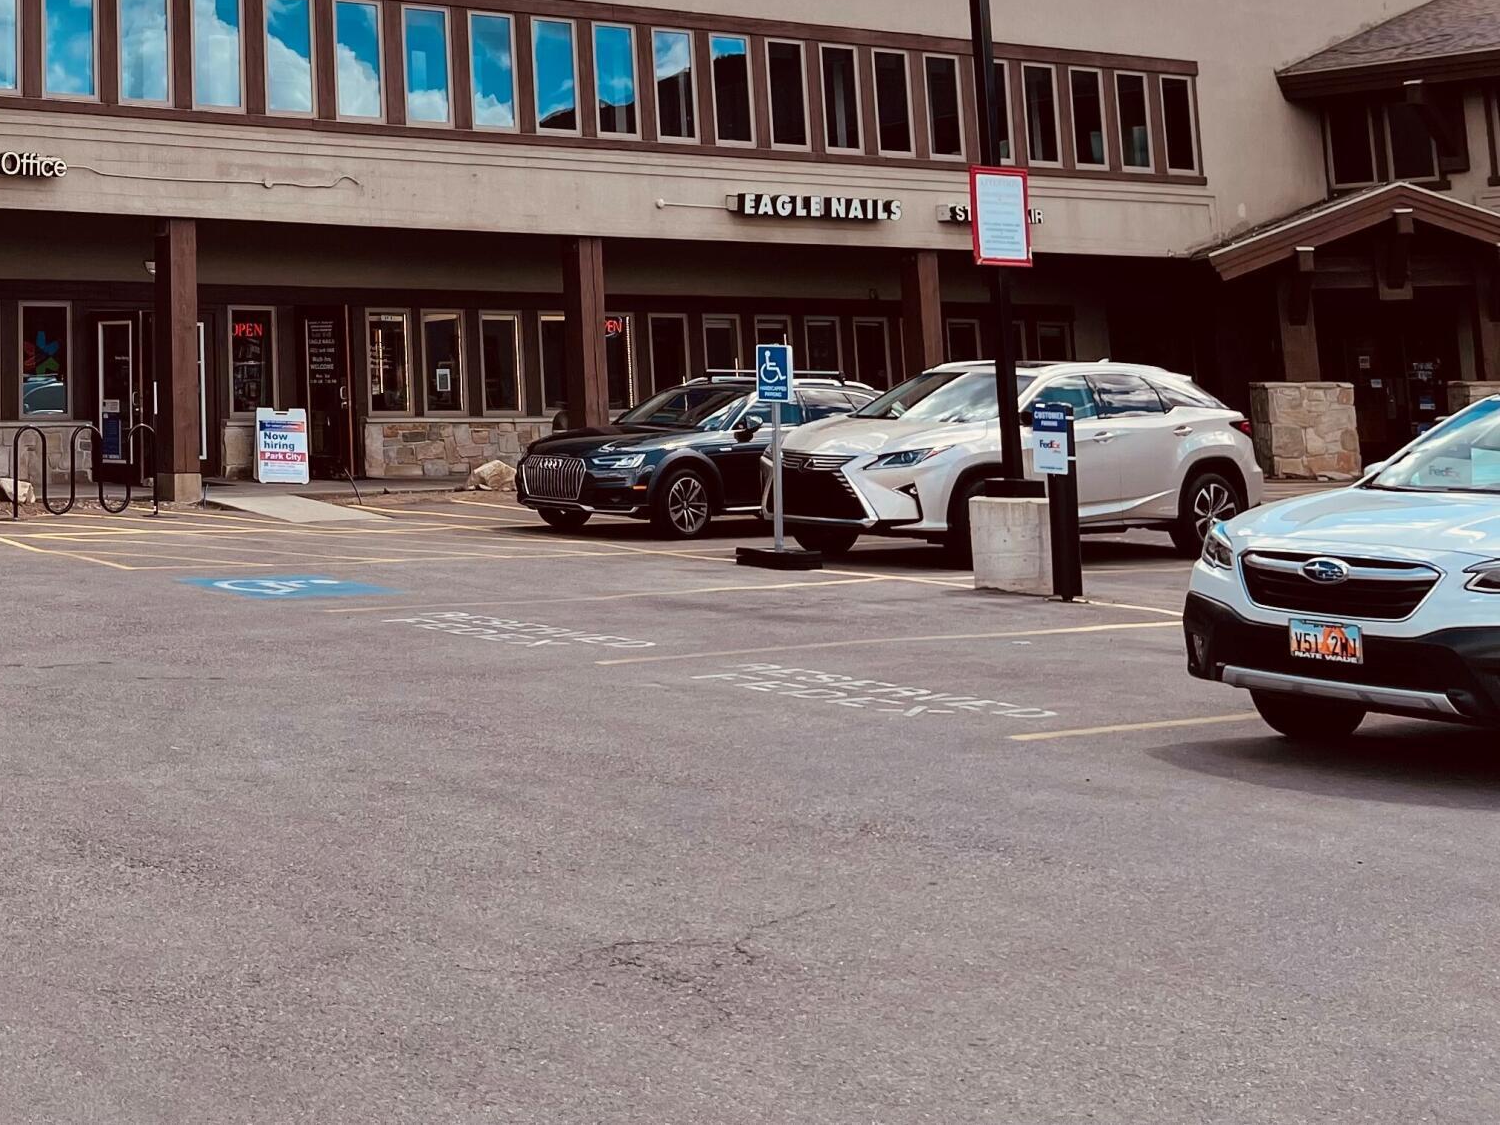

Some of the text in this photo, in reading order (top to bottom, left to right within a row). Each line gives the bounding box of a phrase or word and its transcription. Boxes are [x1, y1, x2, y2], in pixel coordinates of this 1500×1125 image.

[1, 151, 67, 177] Office
[743, 193, 902, 221] EAGLE NAILS
[263, 432, 288, 440] Now
[263, 441, 295, 452] hiring
[1040, 439, 1060, 448] FedEx
[265, 452, 301, 461] Park City
[416, 611, 656, 648] RESERVED
[1294, 651, 1358, 663] NATE WADE
[722, 663, 1057, 717] RESERVED
